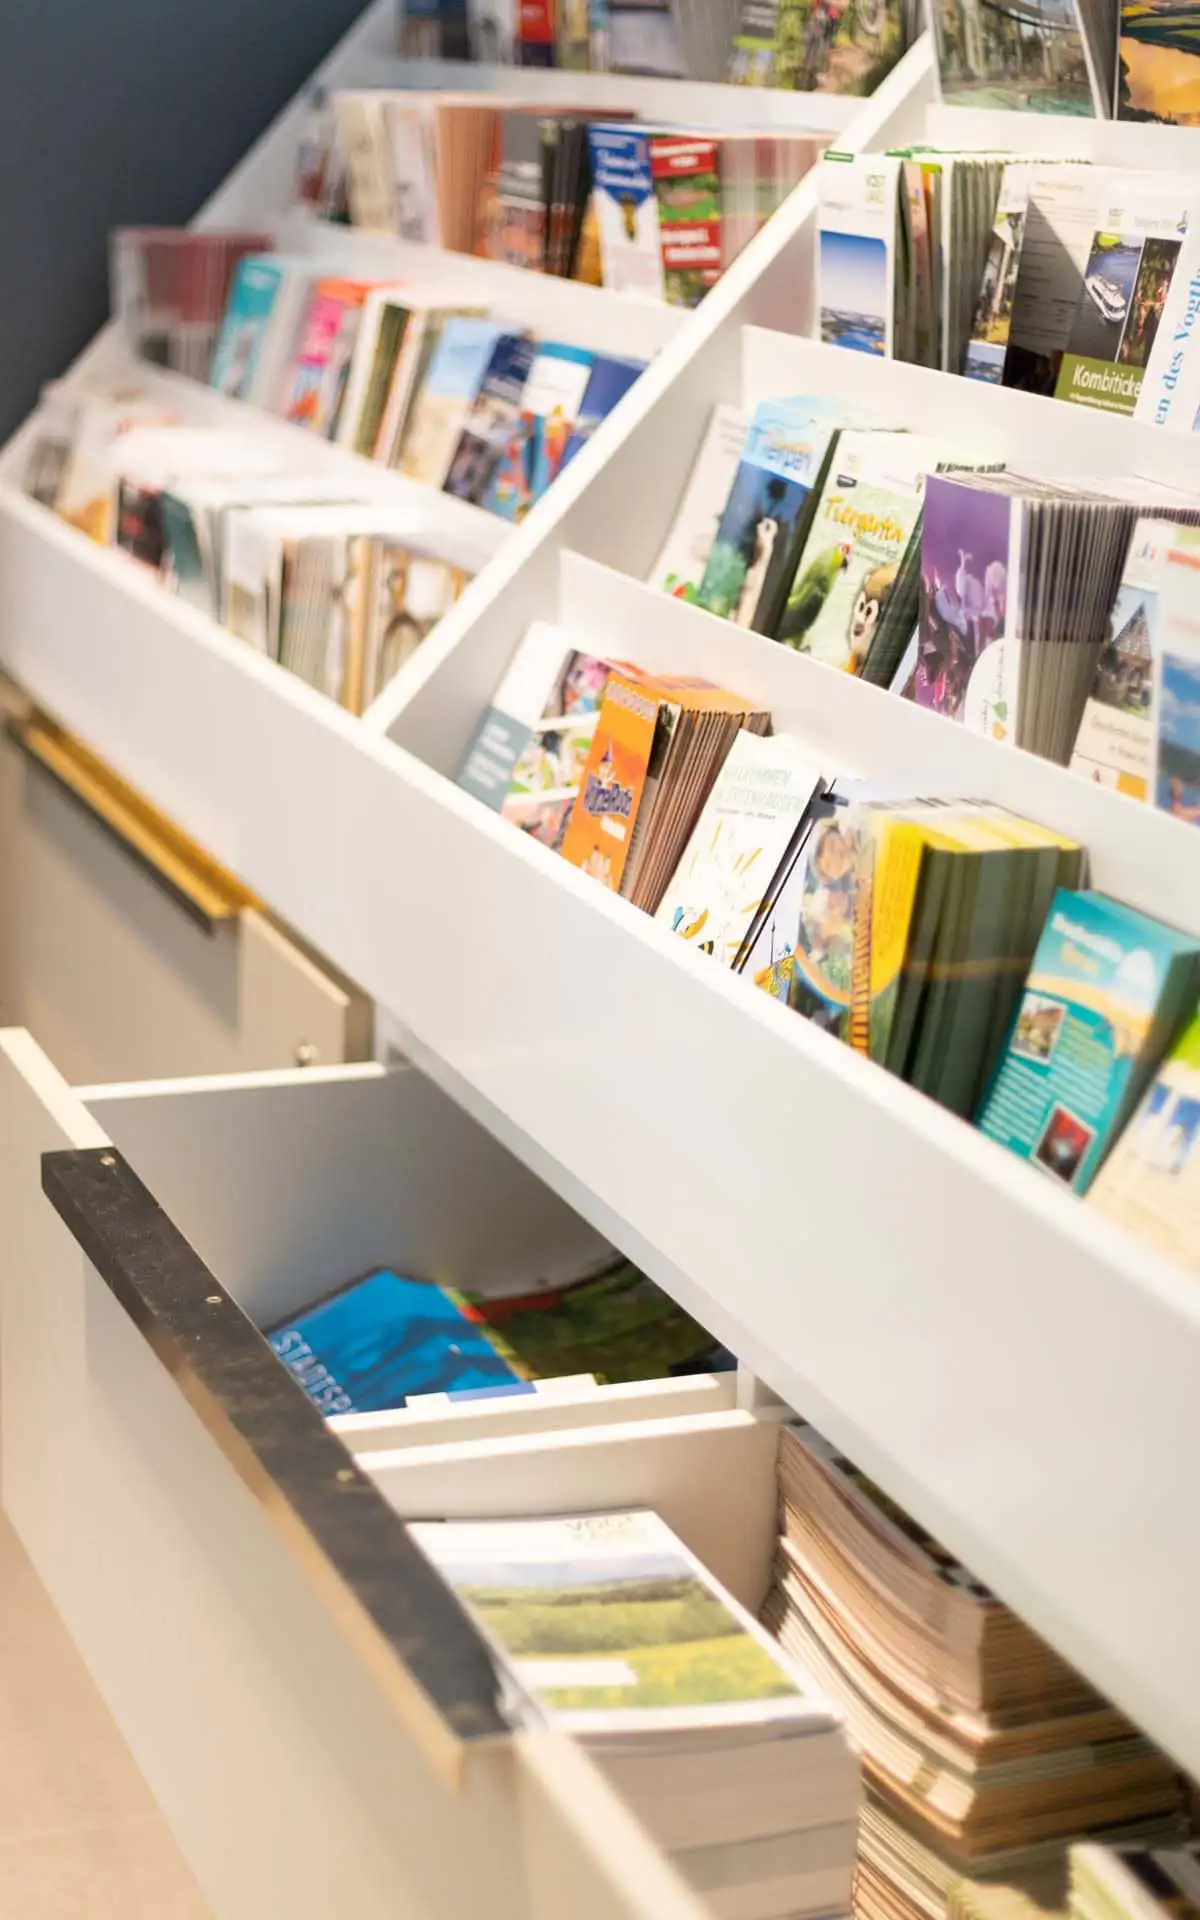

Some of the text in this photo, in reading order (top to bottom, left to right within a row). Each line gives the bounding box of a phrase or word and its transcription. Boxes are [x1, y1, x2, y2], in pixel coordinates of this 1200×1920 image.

[1072, 363, 1142, 397] Kombiticke
[1162, 350, 1185, 391] des
[270, 1330, 359, 1413] STADTSP
